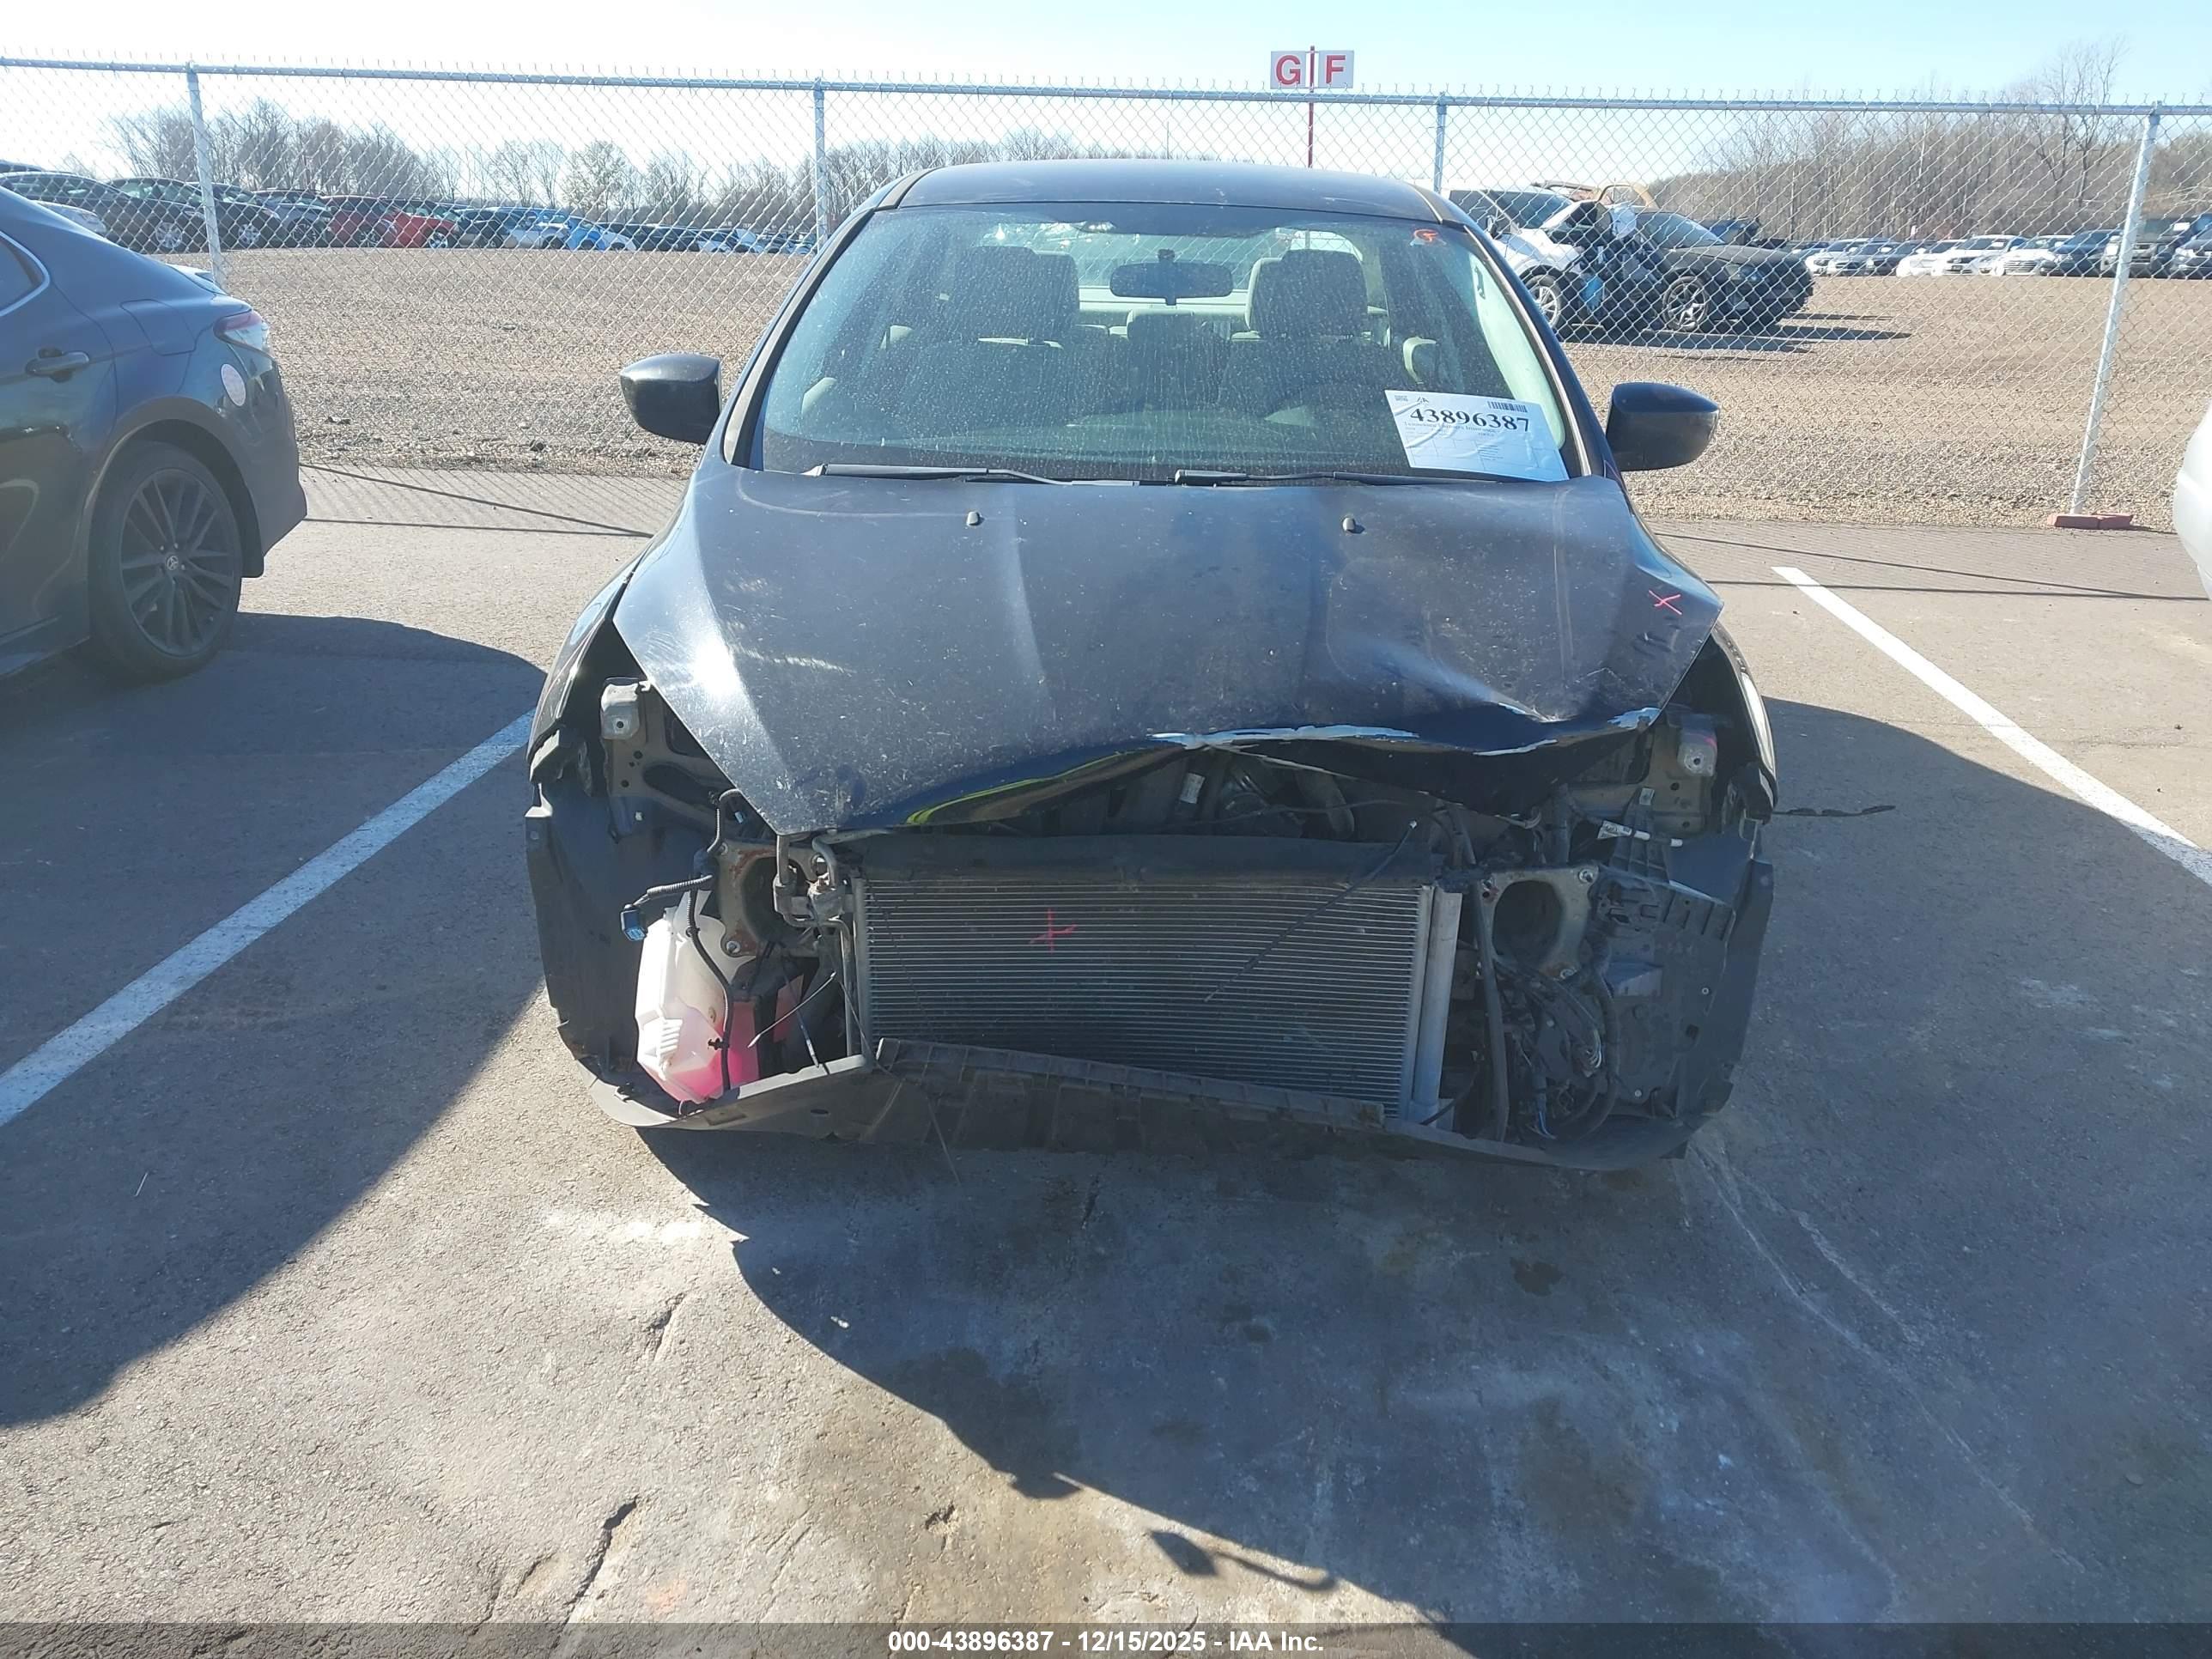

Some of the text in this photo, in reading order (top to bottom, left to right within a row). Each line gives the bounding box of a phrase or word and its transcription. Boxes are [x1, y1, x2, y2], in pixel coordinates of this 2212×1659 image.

[1275, 54, 1346, 85] G F
[1410, 408, 1529, 432] 43896387
